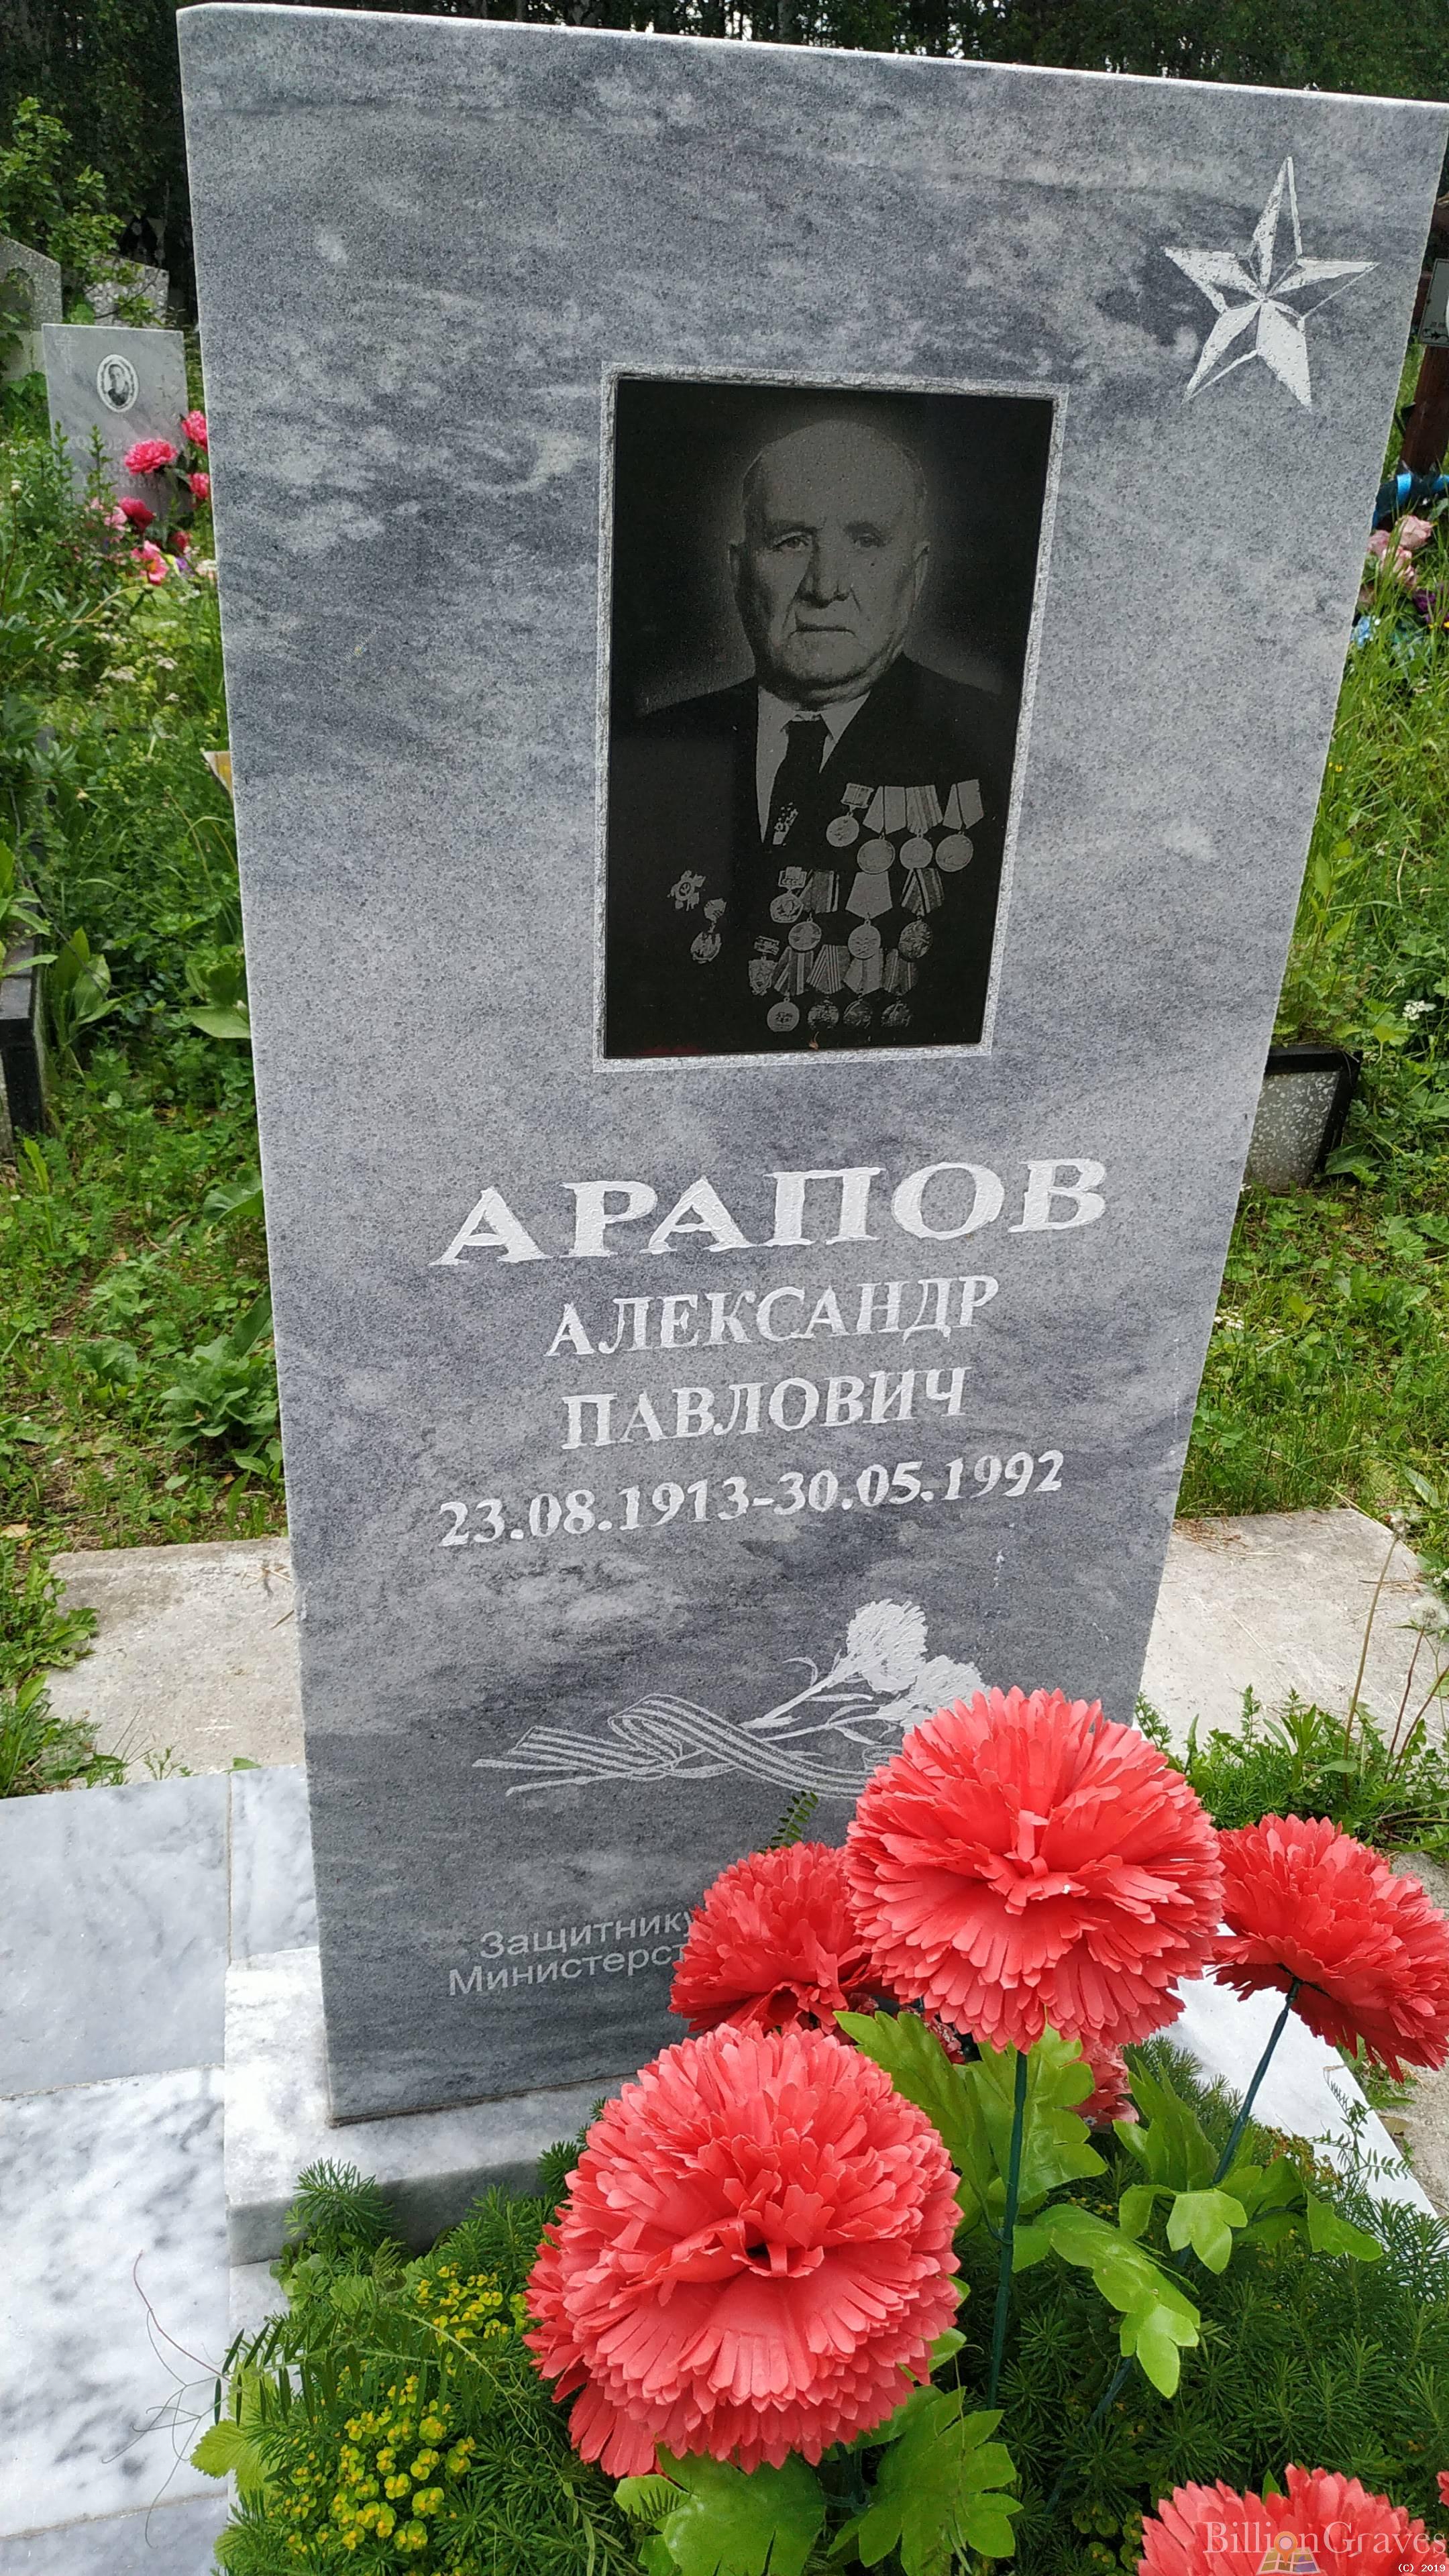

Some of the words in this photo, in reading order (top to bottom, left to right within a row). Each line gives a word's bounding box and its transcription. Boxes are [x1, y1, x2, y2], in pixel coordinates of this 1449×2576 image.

[429, 1159, 1107, 1266] АРАПОВ
[545, 1275, 999, 1356] АЛЕКСАНДР
[561, 1366, 972, 1450] ПАВЛОВИЧ
[439, 1450, 1065, 1547] 23.08.1913-30.05.1992
[449, 1944, 691, 1996] Министерст
